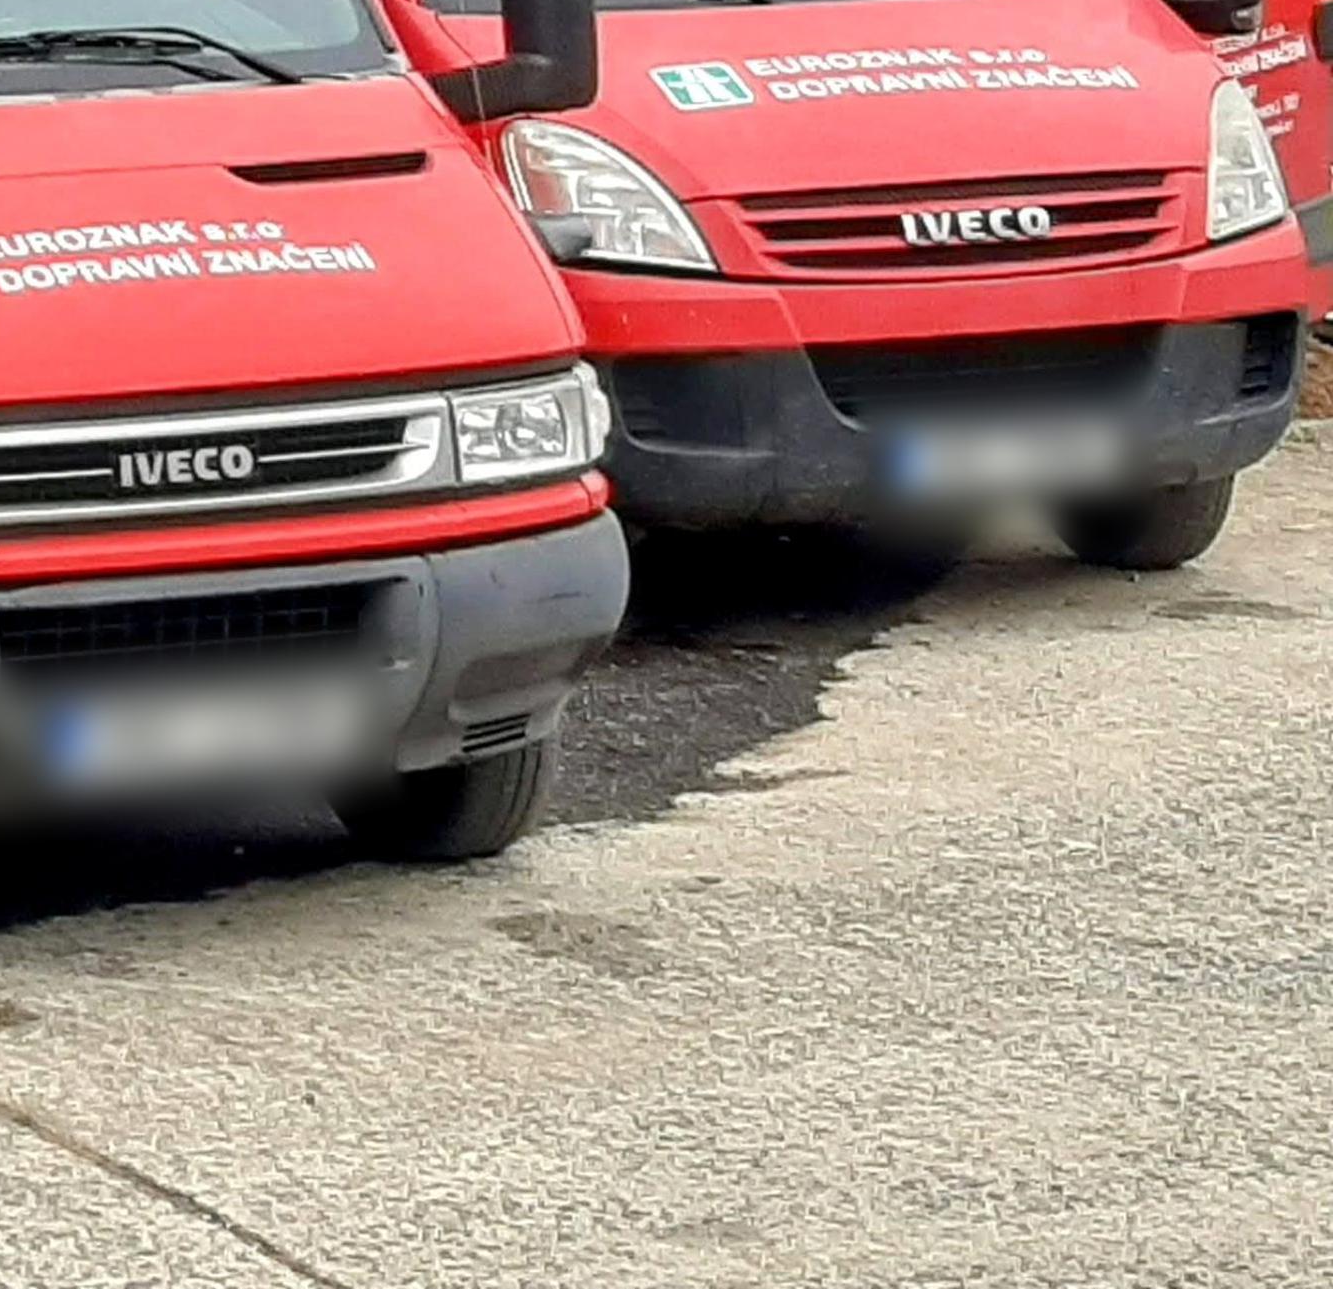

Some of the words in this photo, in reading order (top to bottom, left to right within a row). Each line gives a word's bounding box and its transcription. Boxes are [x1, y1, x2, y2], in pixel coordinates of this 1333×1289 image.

[743, 48, 962, 78] EUROZNAK
[767, 70, 969, 100] DOPRAVNÍ
[971, 63, 1141, 90] ZNAČENÍ
[200, 220, 285, 241] s.r.o
[899, 205, 1054, 247] IVECO
[203, 240, 377, 276] ZNAČENÍ
[116, 443, 255, 488] IVECO
